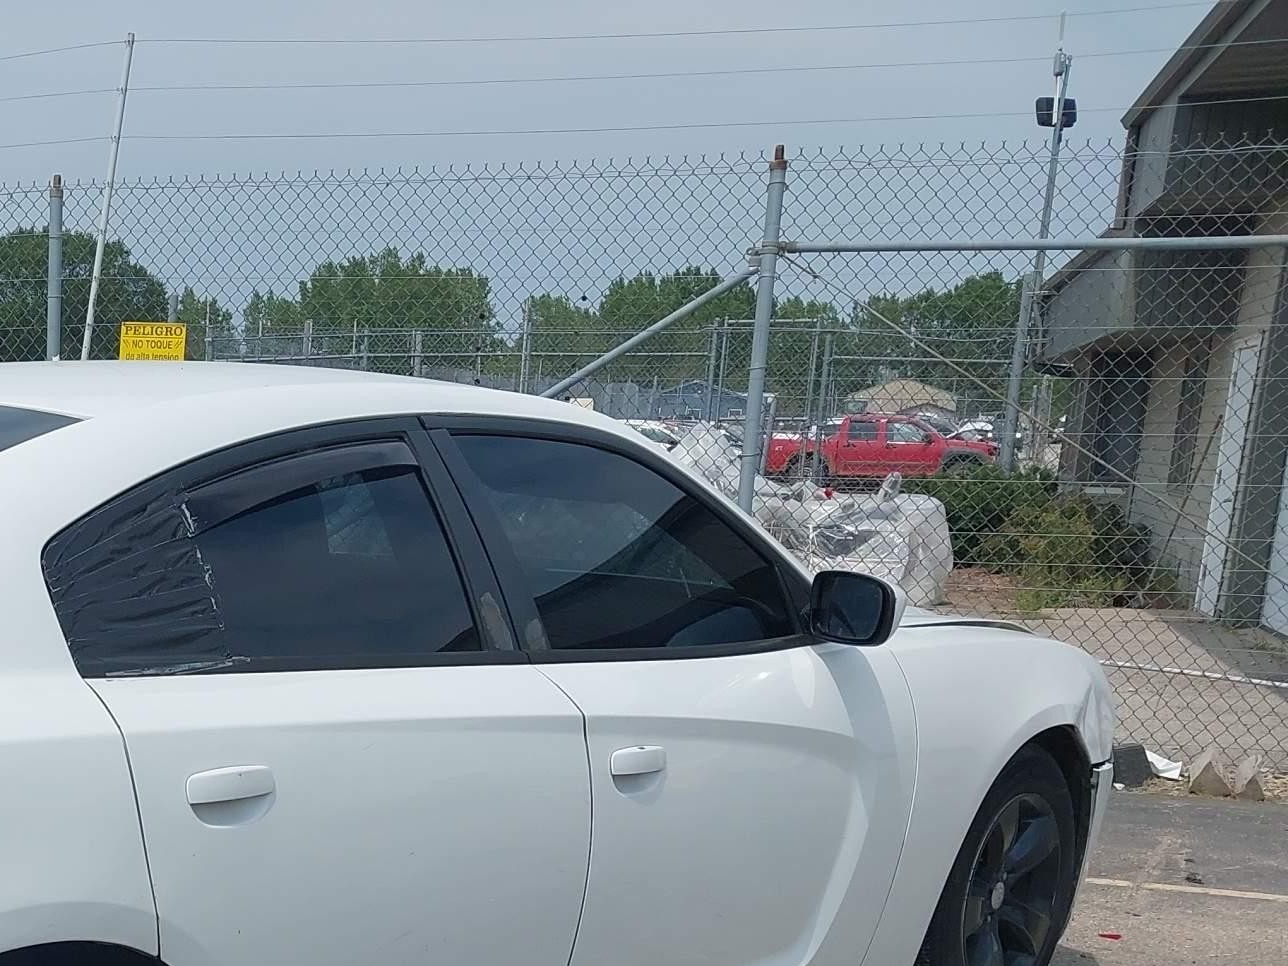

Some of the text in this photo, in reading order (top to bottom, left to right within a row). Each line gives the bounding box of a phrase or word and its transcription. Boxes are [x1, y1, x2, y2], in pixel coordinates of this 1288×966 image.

[125, 326, 183, 336] PELIGRO
[132, 340, 173, 350] NO TOQUE
